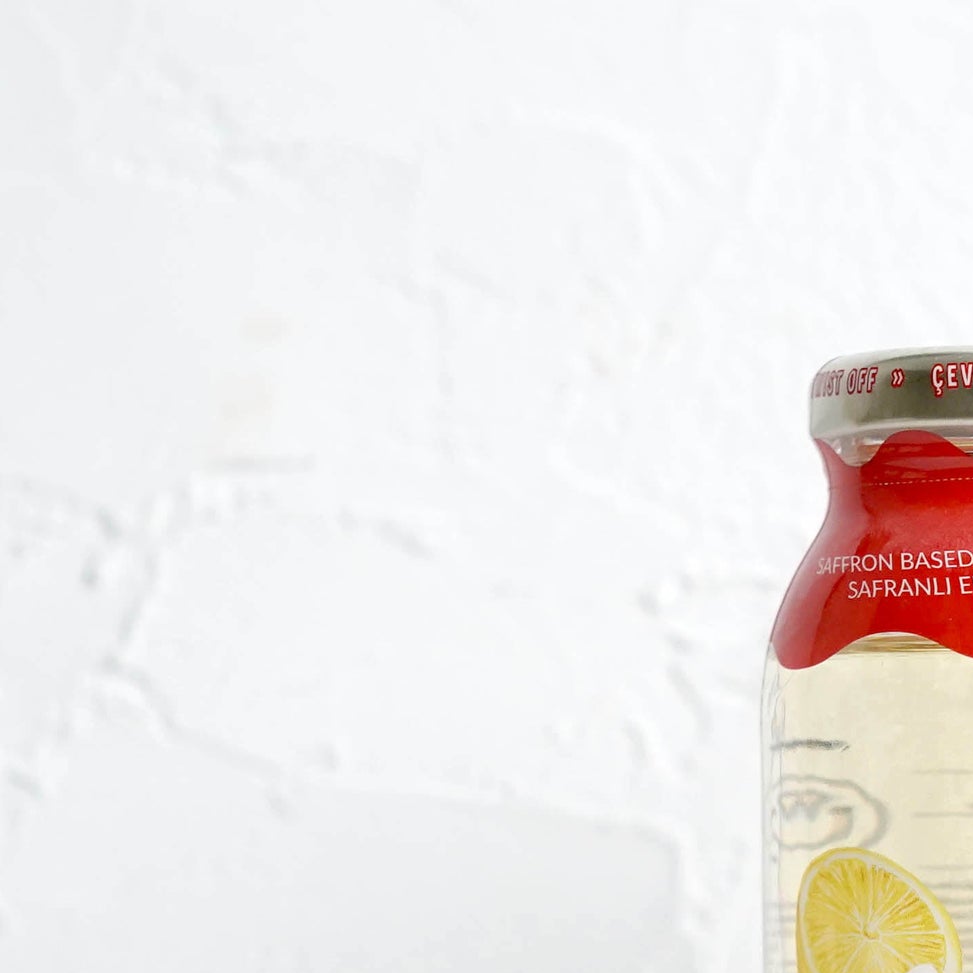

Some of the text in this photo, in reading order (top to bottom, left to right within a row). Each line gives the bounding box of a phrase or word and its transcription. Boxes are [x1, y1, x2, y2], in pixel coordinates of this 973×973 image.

[846, 366, 879, 396] OFF
[816, 554, 893, 574] SAFFRON
[848, 578, 951, 599] SAFRANLI
